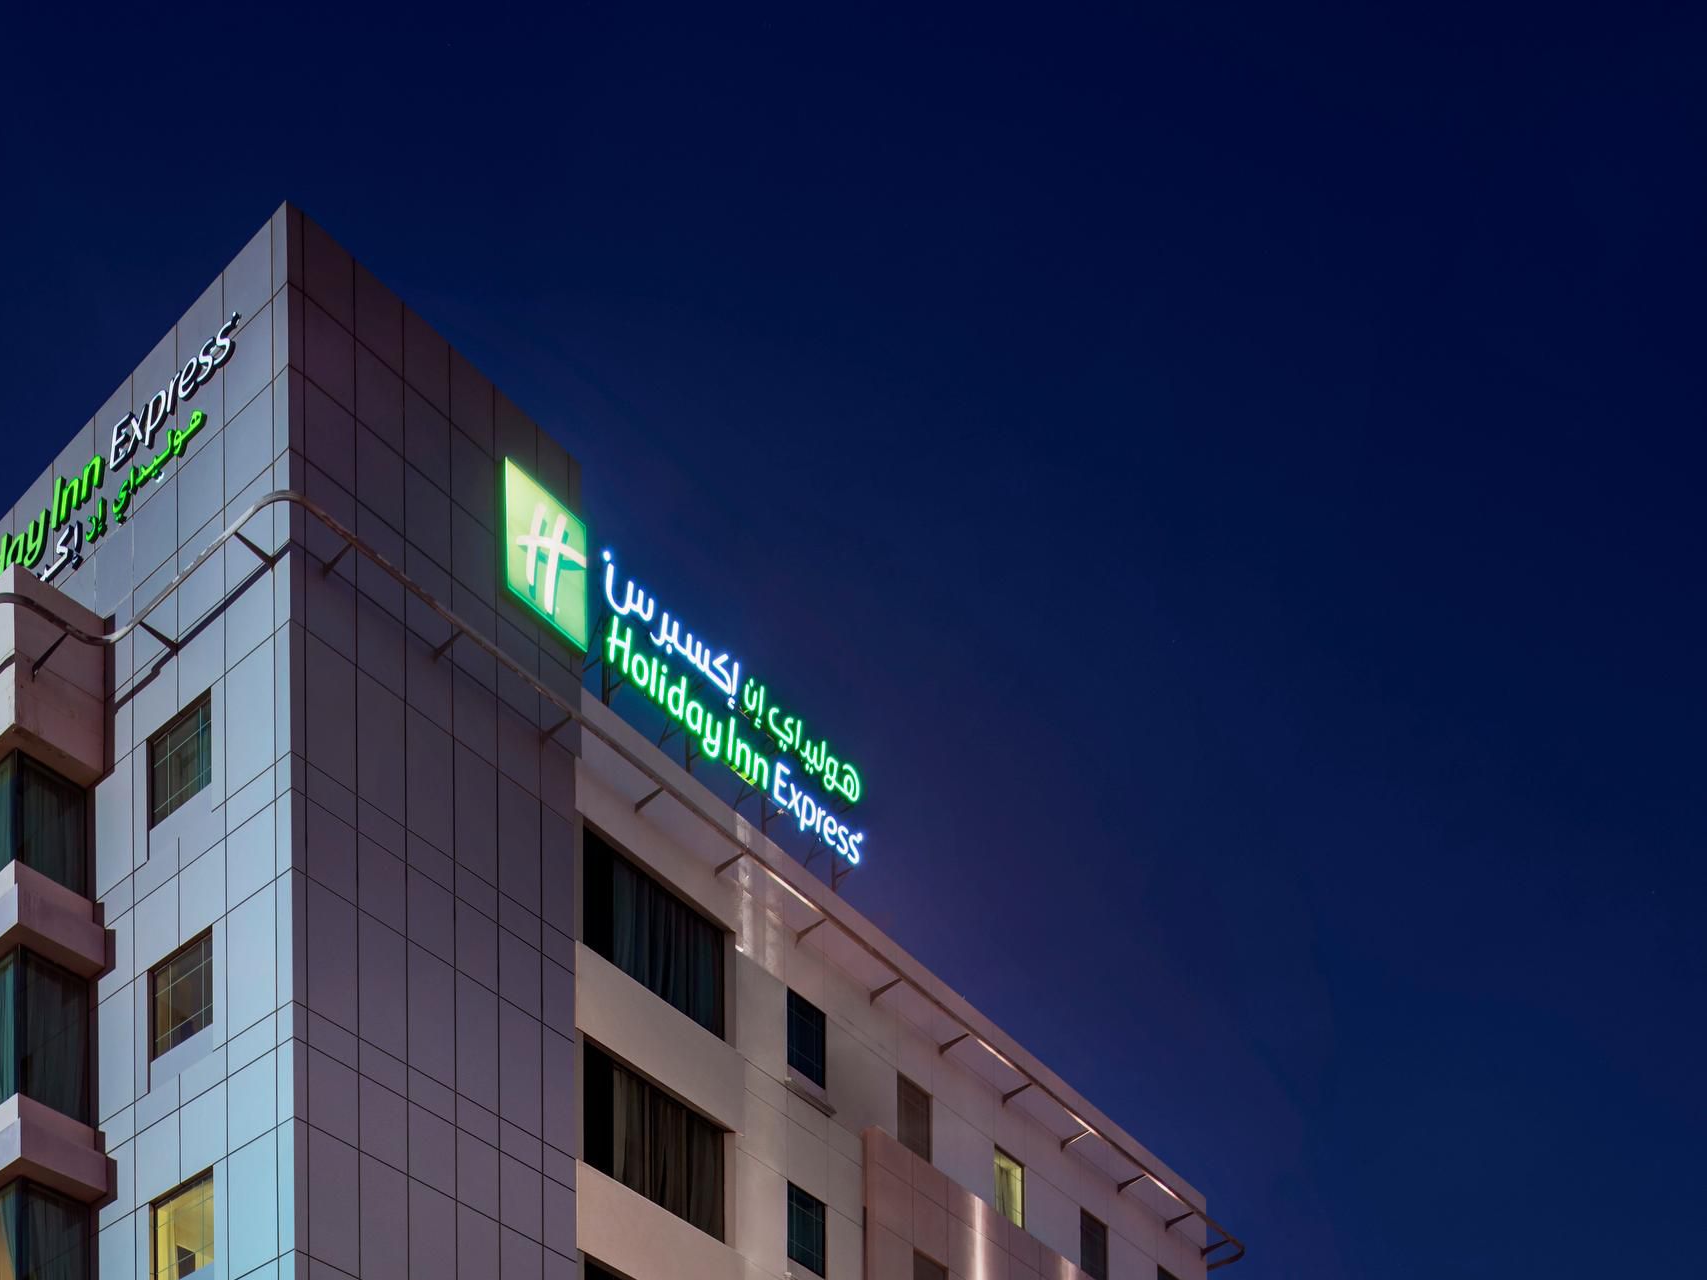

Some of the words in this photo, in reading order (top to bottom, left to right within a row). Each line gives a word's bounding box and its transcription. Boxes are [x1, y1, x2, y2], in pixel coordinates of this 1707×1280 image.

[51, 454, 104, 532] Inn
[109, 320, 236, 472] Express
[606, 614, 722, 758] Holiday
[727, 715, 770, 790] Inn
[772, 760, 861, 865] Express
[744, 677, 765, 729] إن
[767, 706, 861, 802] هوليداي
